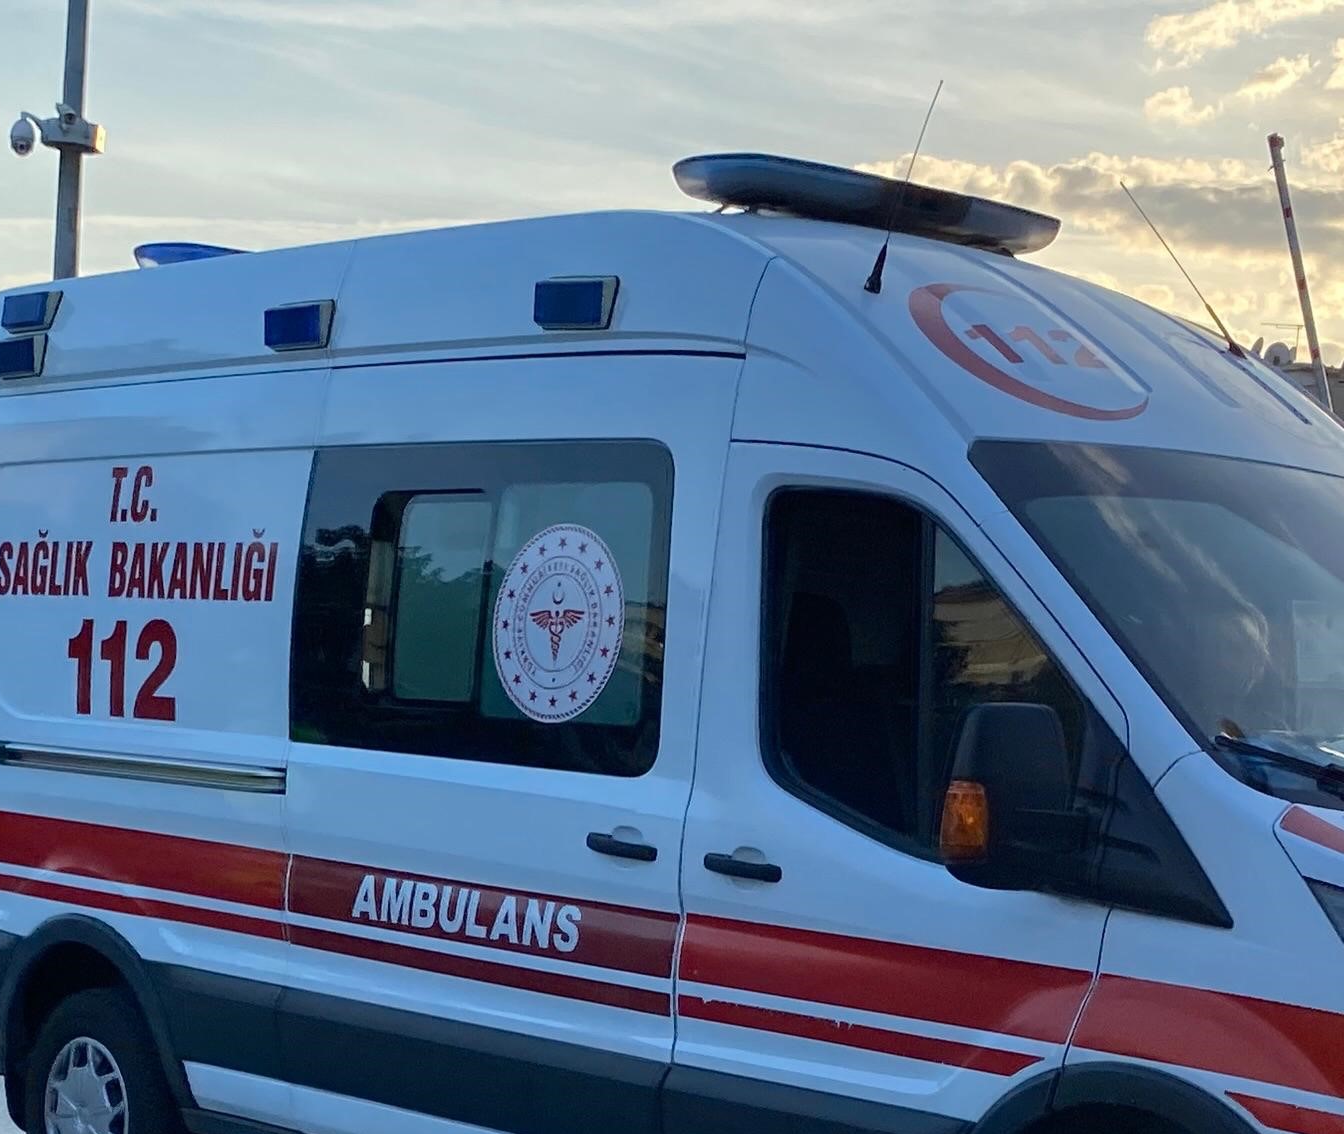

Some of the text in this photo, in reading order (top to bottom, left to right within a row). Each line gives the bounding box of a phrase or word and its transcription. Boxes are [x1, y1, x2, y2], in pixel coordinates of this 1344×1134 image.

[964, 324, 1108, 369] 112
[110, 466, 157, 522] T.C.
[108, 527, 279, 602] BAKANLIĞI
[68, 618, 177, 722] 112
[351, 874, 582, 953] AMBULANS
